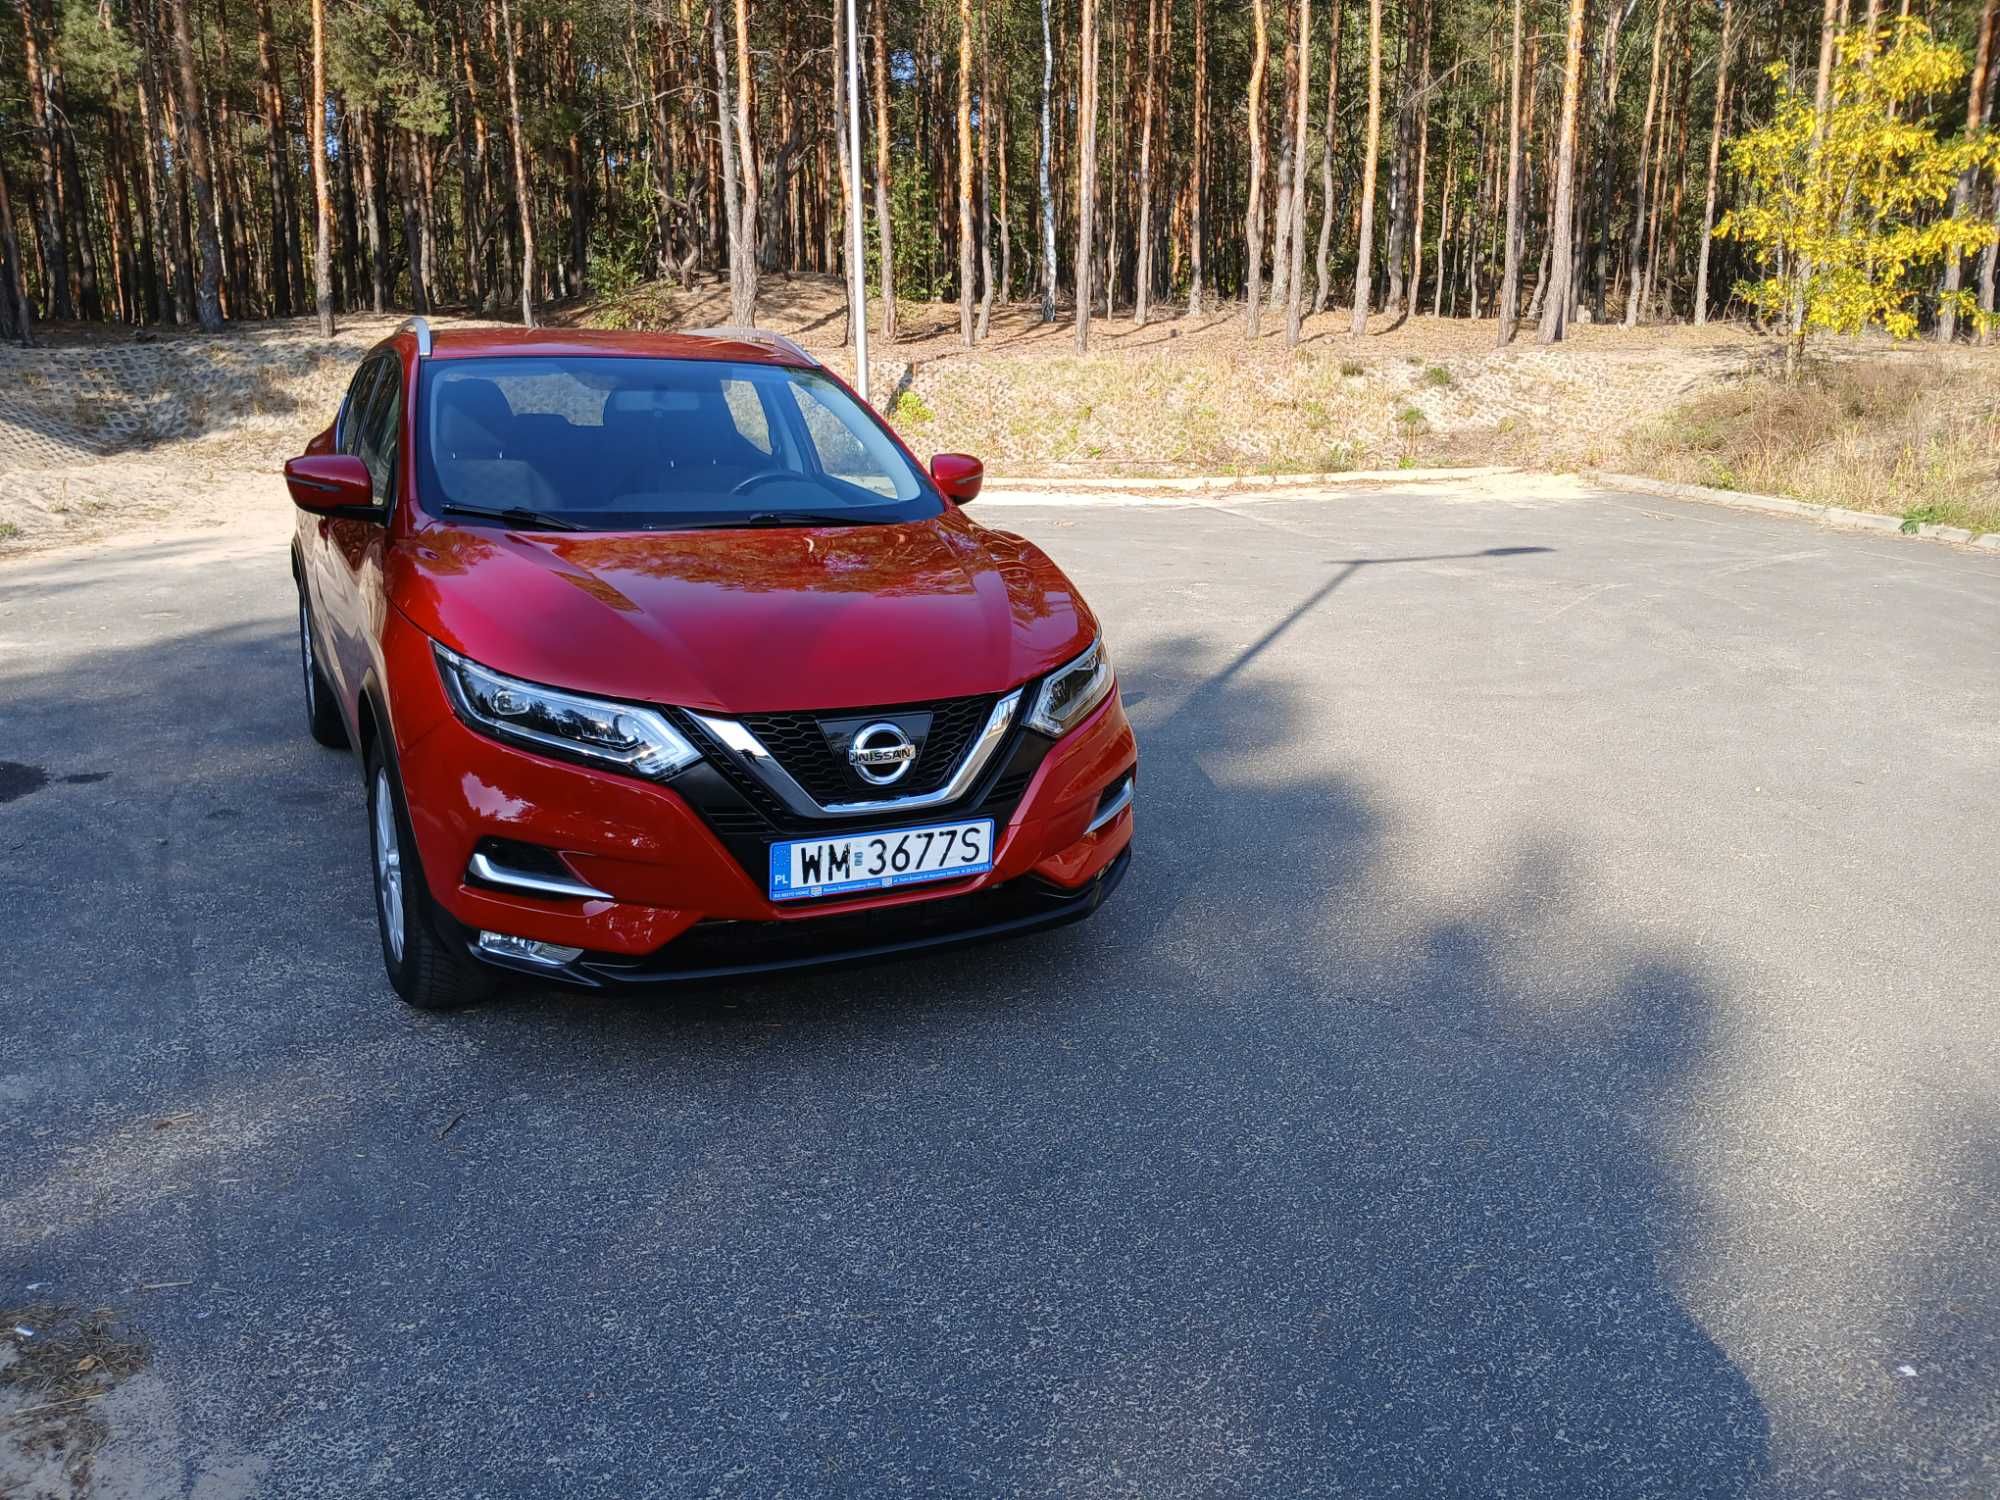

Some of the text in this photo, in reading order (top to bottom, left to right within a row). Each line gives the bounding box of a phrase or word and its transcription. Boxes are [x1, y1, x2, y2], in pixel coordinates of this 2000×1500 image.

[858, 749, 911, 762] NISSAN
[801, 841, 851, 884] WM
[868, 827, 981, 875] 3677S
[774, 874, 789, 885] PL
